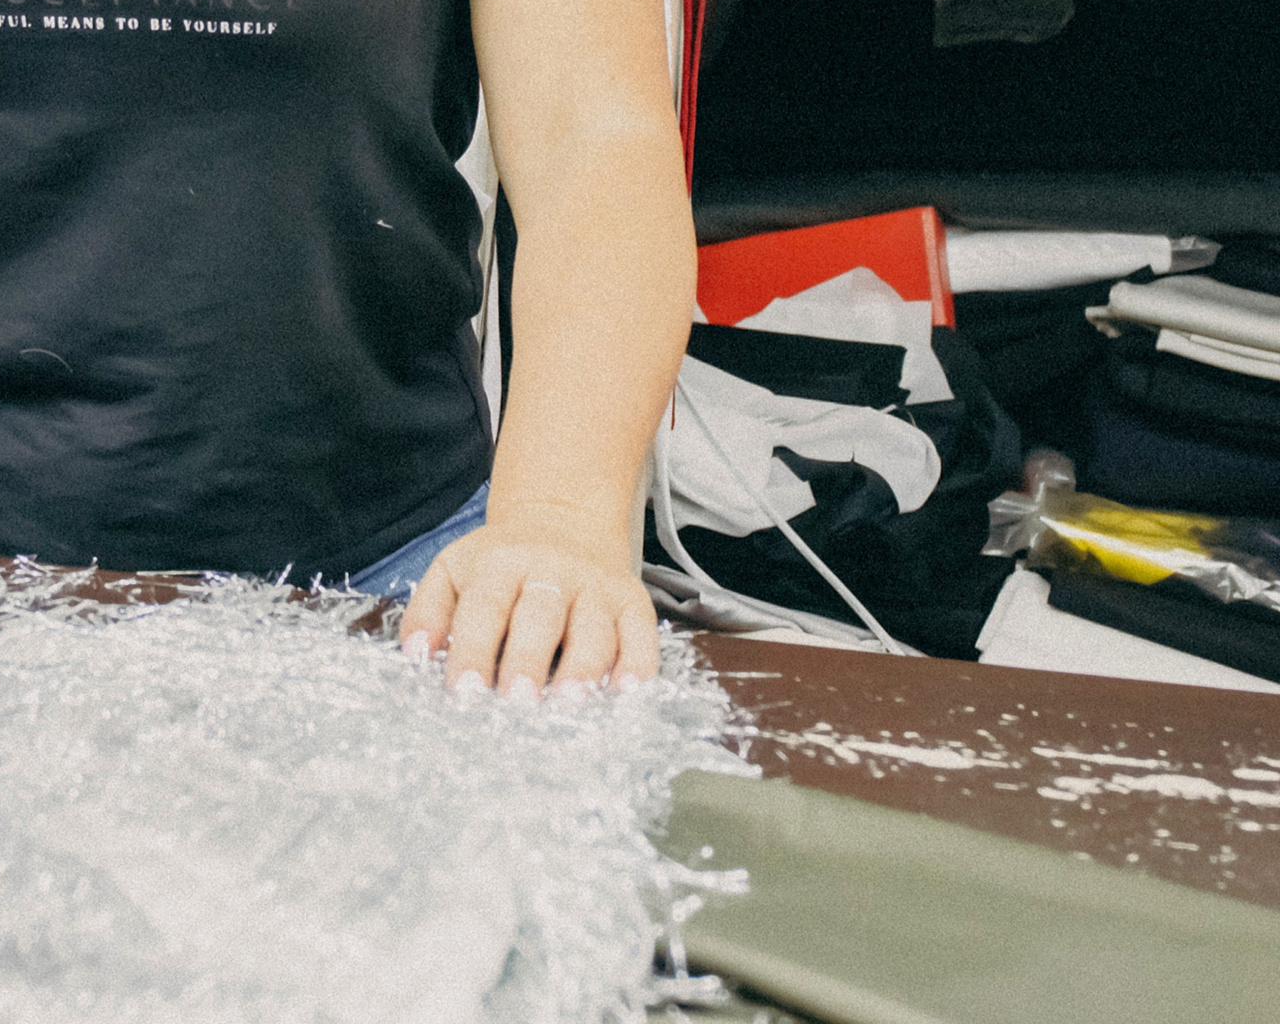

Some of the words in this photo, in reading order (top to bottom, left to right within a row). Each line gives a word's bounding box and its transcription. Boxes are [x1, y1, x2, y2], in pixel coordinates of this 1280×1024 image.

[43, 16, 105, 30] MEANS
[115, 17, 140, 31] TO
[150, 17, 173, 32] BE
[183, 18, 279, 34] YOURSELF
